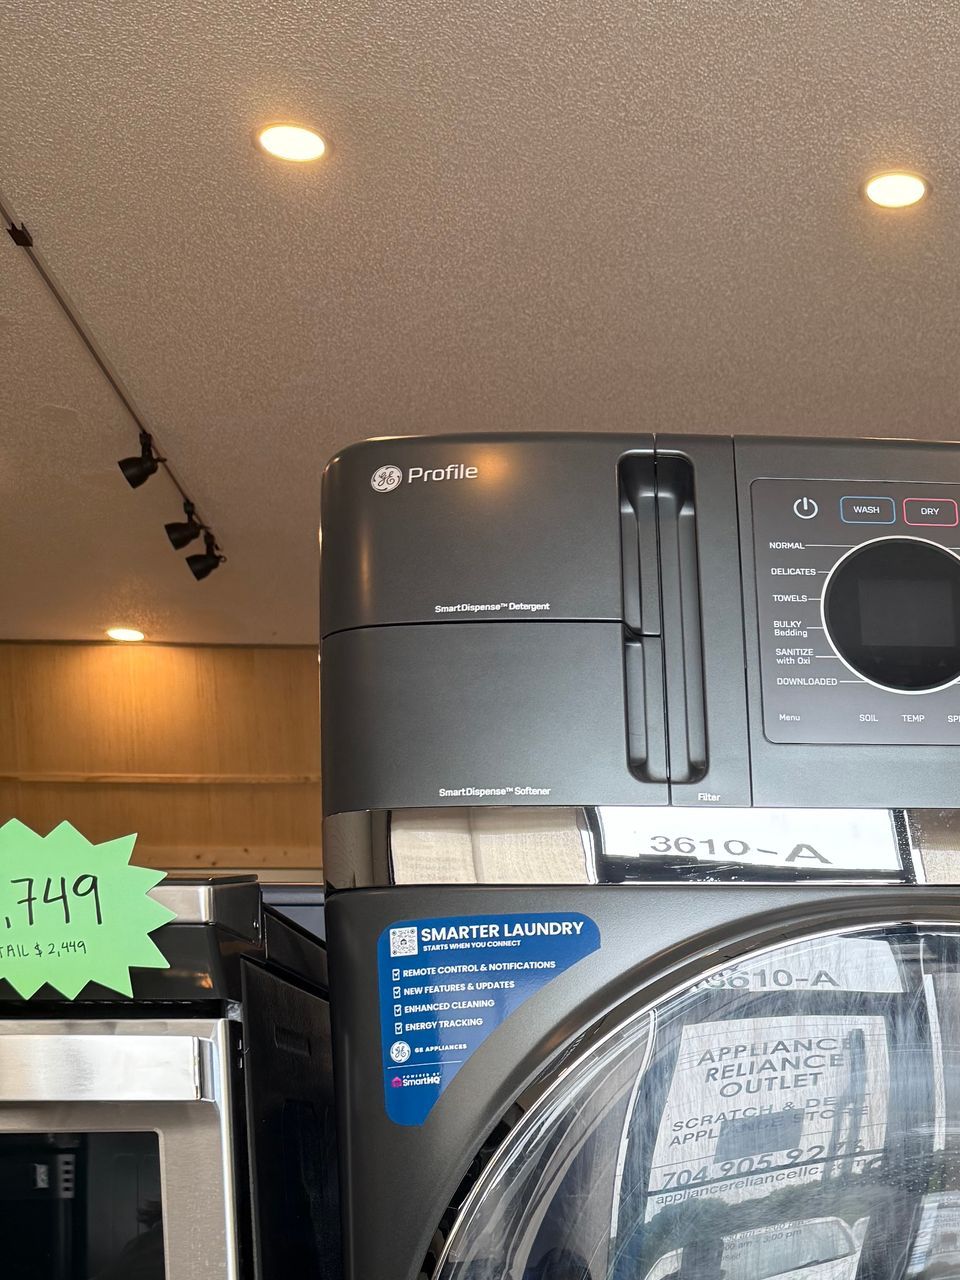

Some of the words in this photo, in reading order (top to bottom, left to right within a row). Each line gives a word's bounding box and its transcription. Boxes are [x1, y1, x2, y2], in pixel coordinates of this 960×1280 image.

[407, 463, 479, 484] Profile
[853, 505, 880, 514] WASH
[920, 507, 940, 516] DRY
[769, 541, 805, 550] NORMAL
[770, 567, 816, 576] DELICATES
[772, 594, 808, 602] TOWELS
[508, 602, 550, 612] Detergent
[773, 619, 802, 628] BULKY
[774, 628, 809, 638] Bedding
[775, 648, 814, 657] SANITIZE
[776, 656, 795, 665] with
[796, 656, 811, 665] Oxi
[776, 677, 838, 686] DOWNLOADED
[779, 712, 801, 722] Menu
[859, 713, 878, 722] SOIL
[901, 714, 925, 723] TEMP
[514, 786, 551, 796] Softener
[697, 792, 721, 802] Filter
[650, 835, 833, 864] 3610-A
[421, 924, 500, 942] SMARTER
[504, 921, 584, 938] LAUNDRY
[423, 944, 449, 952] STARTS
[449, 943, 471, 951] WHEN
[471, 941, 486, 949] YOU
[486, 940, 521, 948] CONNECT
[403, 967, 437, 977] REMOTE
[437, 964, 479, 975] CONTROL
[480, 963, 488, 972] &
[488, 960, 556, 972] NOTIFICATIONS
[403, 987, 423, 996] NEW
[424, 983, 466, 994] FEATURES
[467, 983, 475, 991] &
[475, 980, 515, 990] UPDATES
[404, 1003, 450, 1014] ENHANCED
[451, 999, 495, 1010] CLEANING
[405, 1020, 438, 1031] ENERGY
[438, 1017, 484, 1028] TRACKING
[425, 1043, 468, 1053] APPLIANCES
[705, 1054, 844, 1083] RELIANCE
[719, 1072, 823, 1098] OUTLET
[672, 1104, 773, 1132] SCRATCH
[783, 1101, 795, 1111] &
